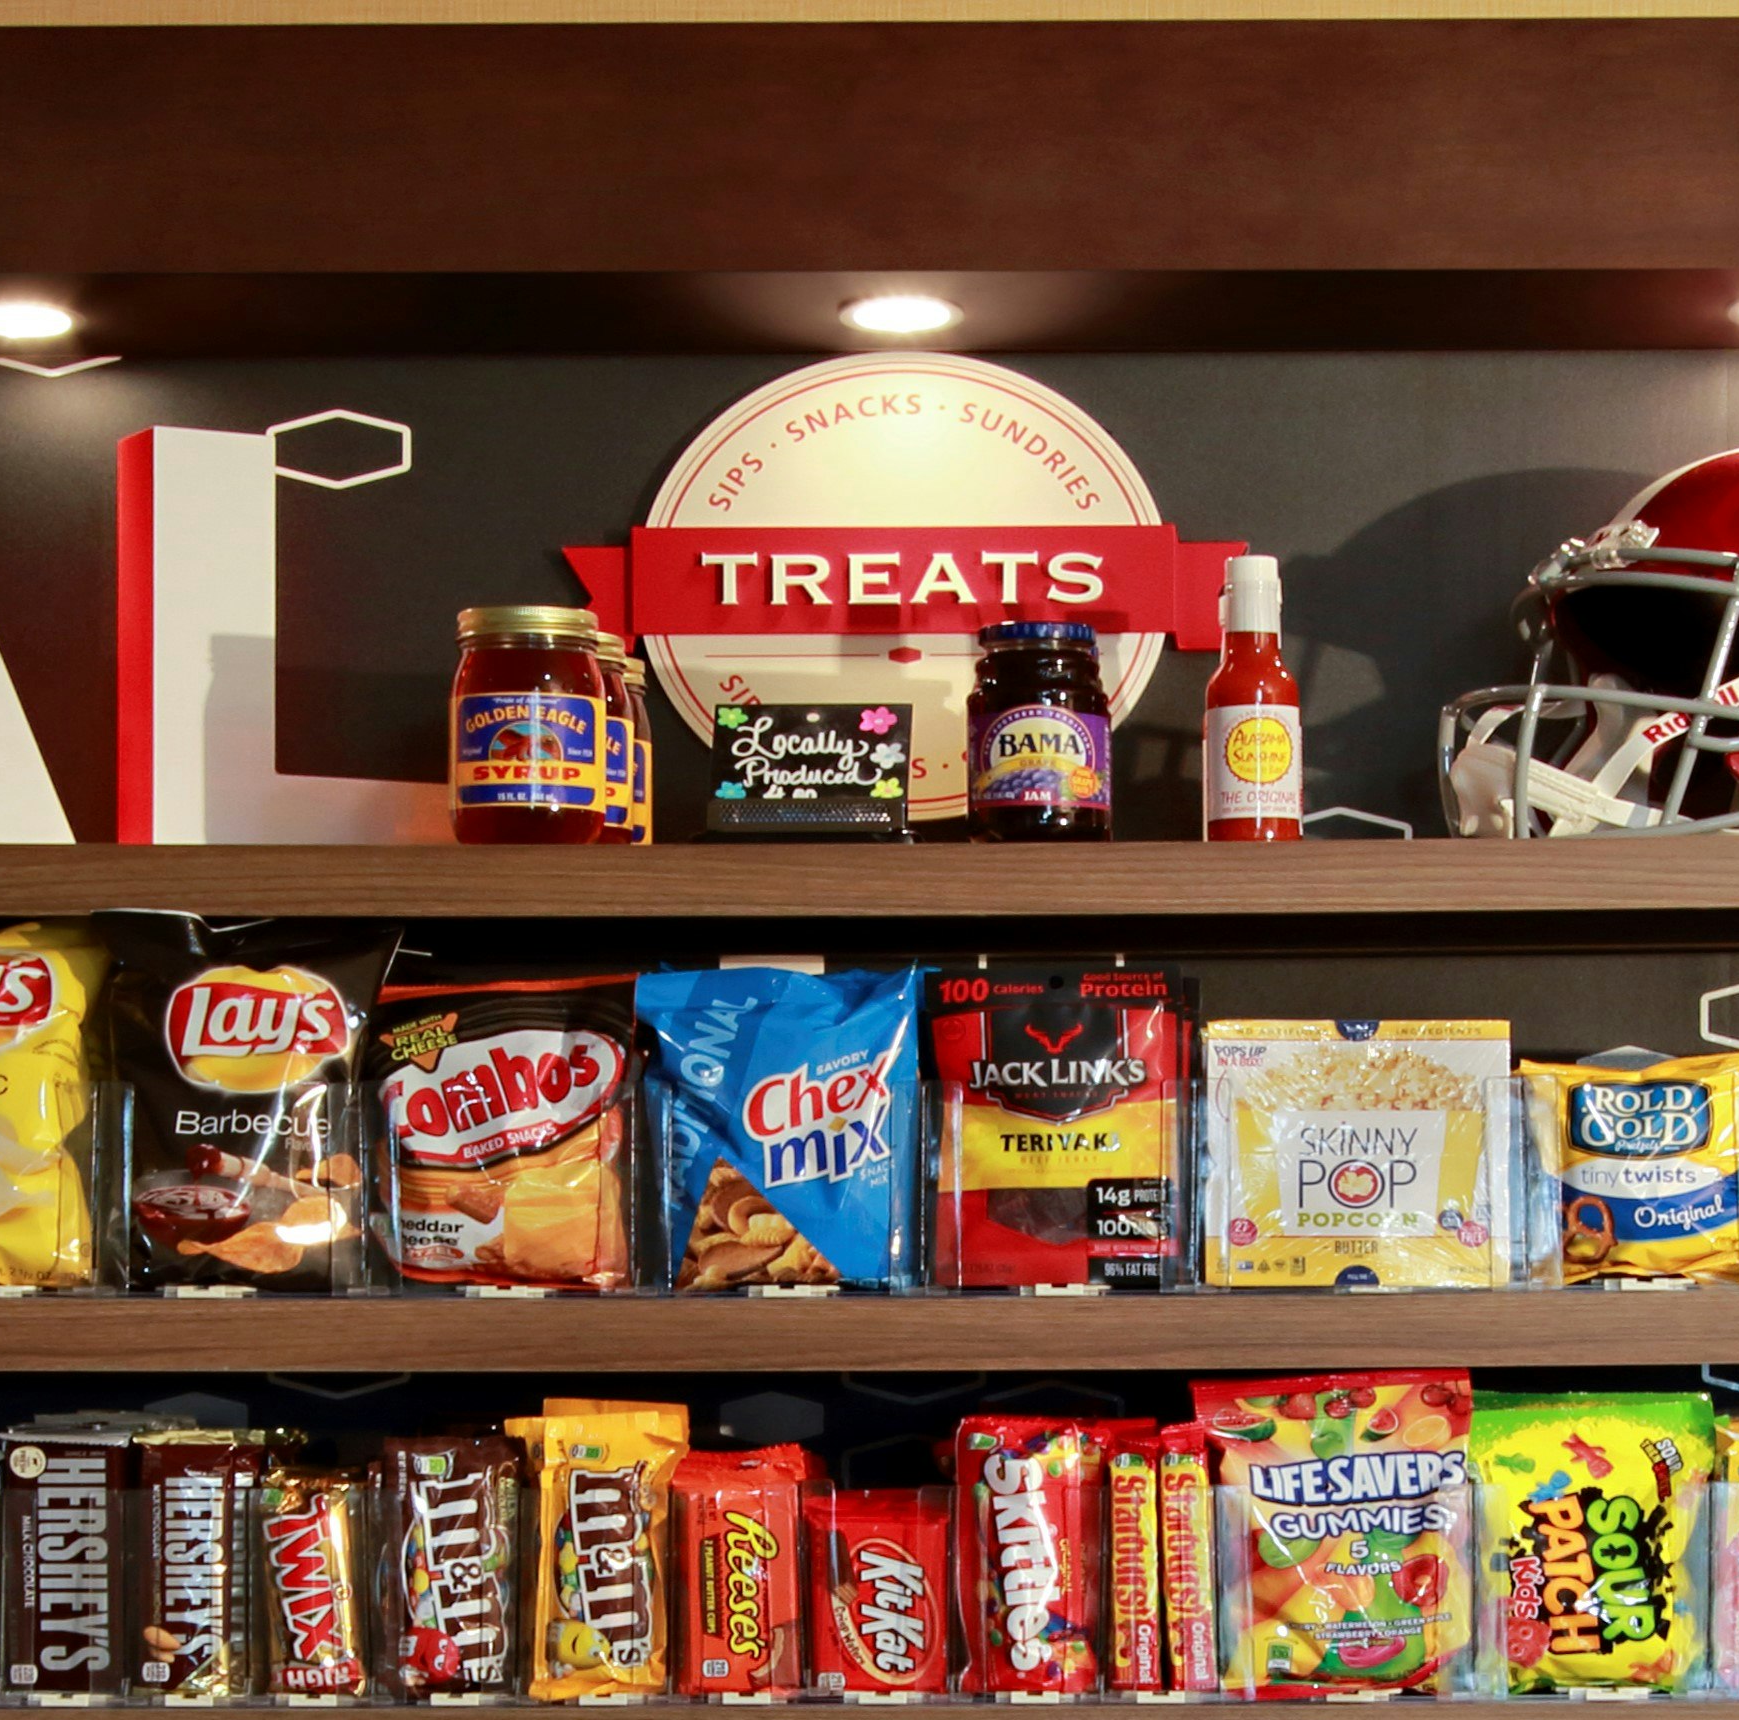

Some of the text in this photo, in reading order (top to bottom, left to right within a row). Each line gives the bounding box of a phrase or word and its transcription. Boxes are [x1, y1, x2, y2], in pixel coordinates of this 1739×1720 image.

[708, 393, 1101, 512] SIPS SNACKS SUNDRIES
[701, 551, 1104, 606] TREATS
[465, 705, 588, 735] GOLDEN EAGLE
[731, 716, 870, 771] Locally
[998, 733, 1083, 758] BAMA
[473, 766, 581, 781] SYRUP
[734, 756, 883, 789] Produced
[1024, 789, 1052, 801] JAM
[1221, 790, 1297, 804] THE ORIGINAL
[939, 978, 1045, 1003] 100 Calories
[1079, 980, 1169, 998] Protein
[181, 985, 335, 1058] Lay's
[395, 1025, 449, 1047] REAL
[391, 1033, 459, 1062] CHEESE
[815, 1049, 871, 1076] SAVORY
[1213, 1045, 1268, 1057] POPS UP
[969, 1058, 1146, 1089] JACK LINK'S
[746, 1049, 902, 1138] Chex
[1589, 1083, 1693, 1115] ROLD
[174, 1109, 332, 1138] Barbecue
[463, 1122, 558, 1159] BAKED SNACKS
[1297, 1120, 1419, 1157] SKINNY
[1580, 1107, 1699, 1149] GOLD
[769, 1104, 887, 1183] mix
[1612, 1137, 1662, 1155] Pretzels
[1297, 1159, 1418, 1209] POP
[1579, 1163, 1697, 1189] tiny twists
[1095, 1186, 1131, 1207] 14g
[1634, 1199, 1725, 1230] Original
[1096, 1219, 1131, 1236] 100
[1334, 1240, 1379, 1255] BUTTER
[1655, 1438, 1683, 1476] SOUR
[1250, 1450, 1465, 1503] LIFE SAVERS
[1271, 1503, 1445, 1540] GUMMIES
[21, 1515, 35, 1608] MILK CHOCOLATE
[983, 1448, 1061, 1671] Skittles
[1113, 1473, 1151, 1621] Starburst
[1163, 1471, 1202, 1620] Starburst
[1350, 1540, 1369, 1559] 5
[36, 1457, 111, 1673] HERSHEY'S
[164, 1476, 225, 1659] HERSHEY'S
[264, 1493, 342, 1662] TWIX
[1325, 1559, 1402, 1576] FLAVORS
[1526, 1494, 1601, 1655] PATCH
[1586, 1496, 1658, 1642] SOUR
[704, 1546, 716, 1633] PEANUT BUTTER CUPS
[724, 1509, 780, 1660] Reese's
[1510, 1555, 1546, 1621] Kids
[861, 1550, 925, 1673] Kit Kat
[1134, 1623, 1152, 1684] Original
[1190, 1620, 1210, 1681] Original
